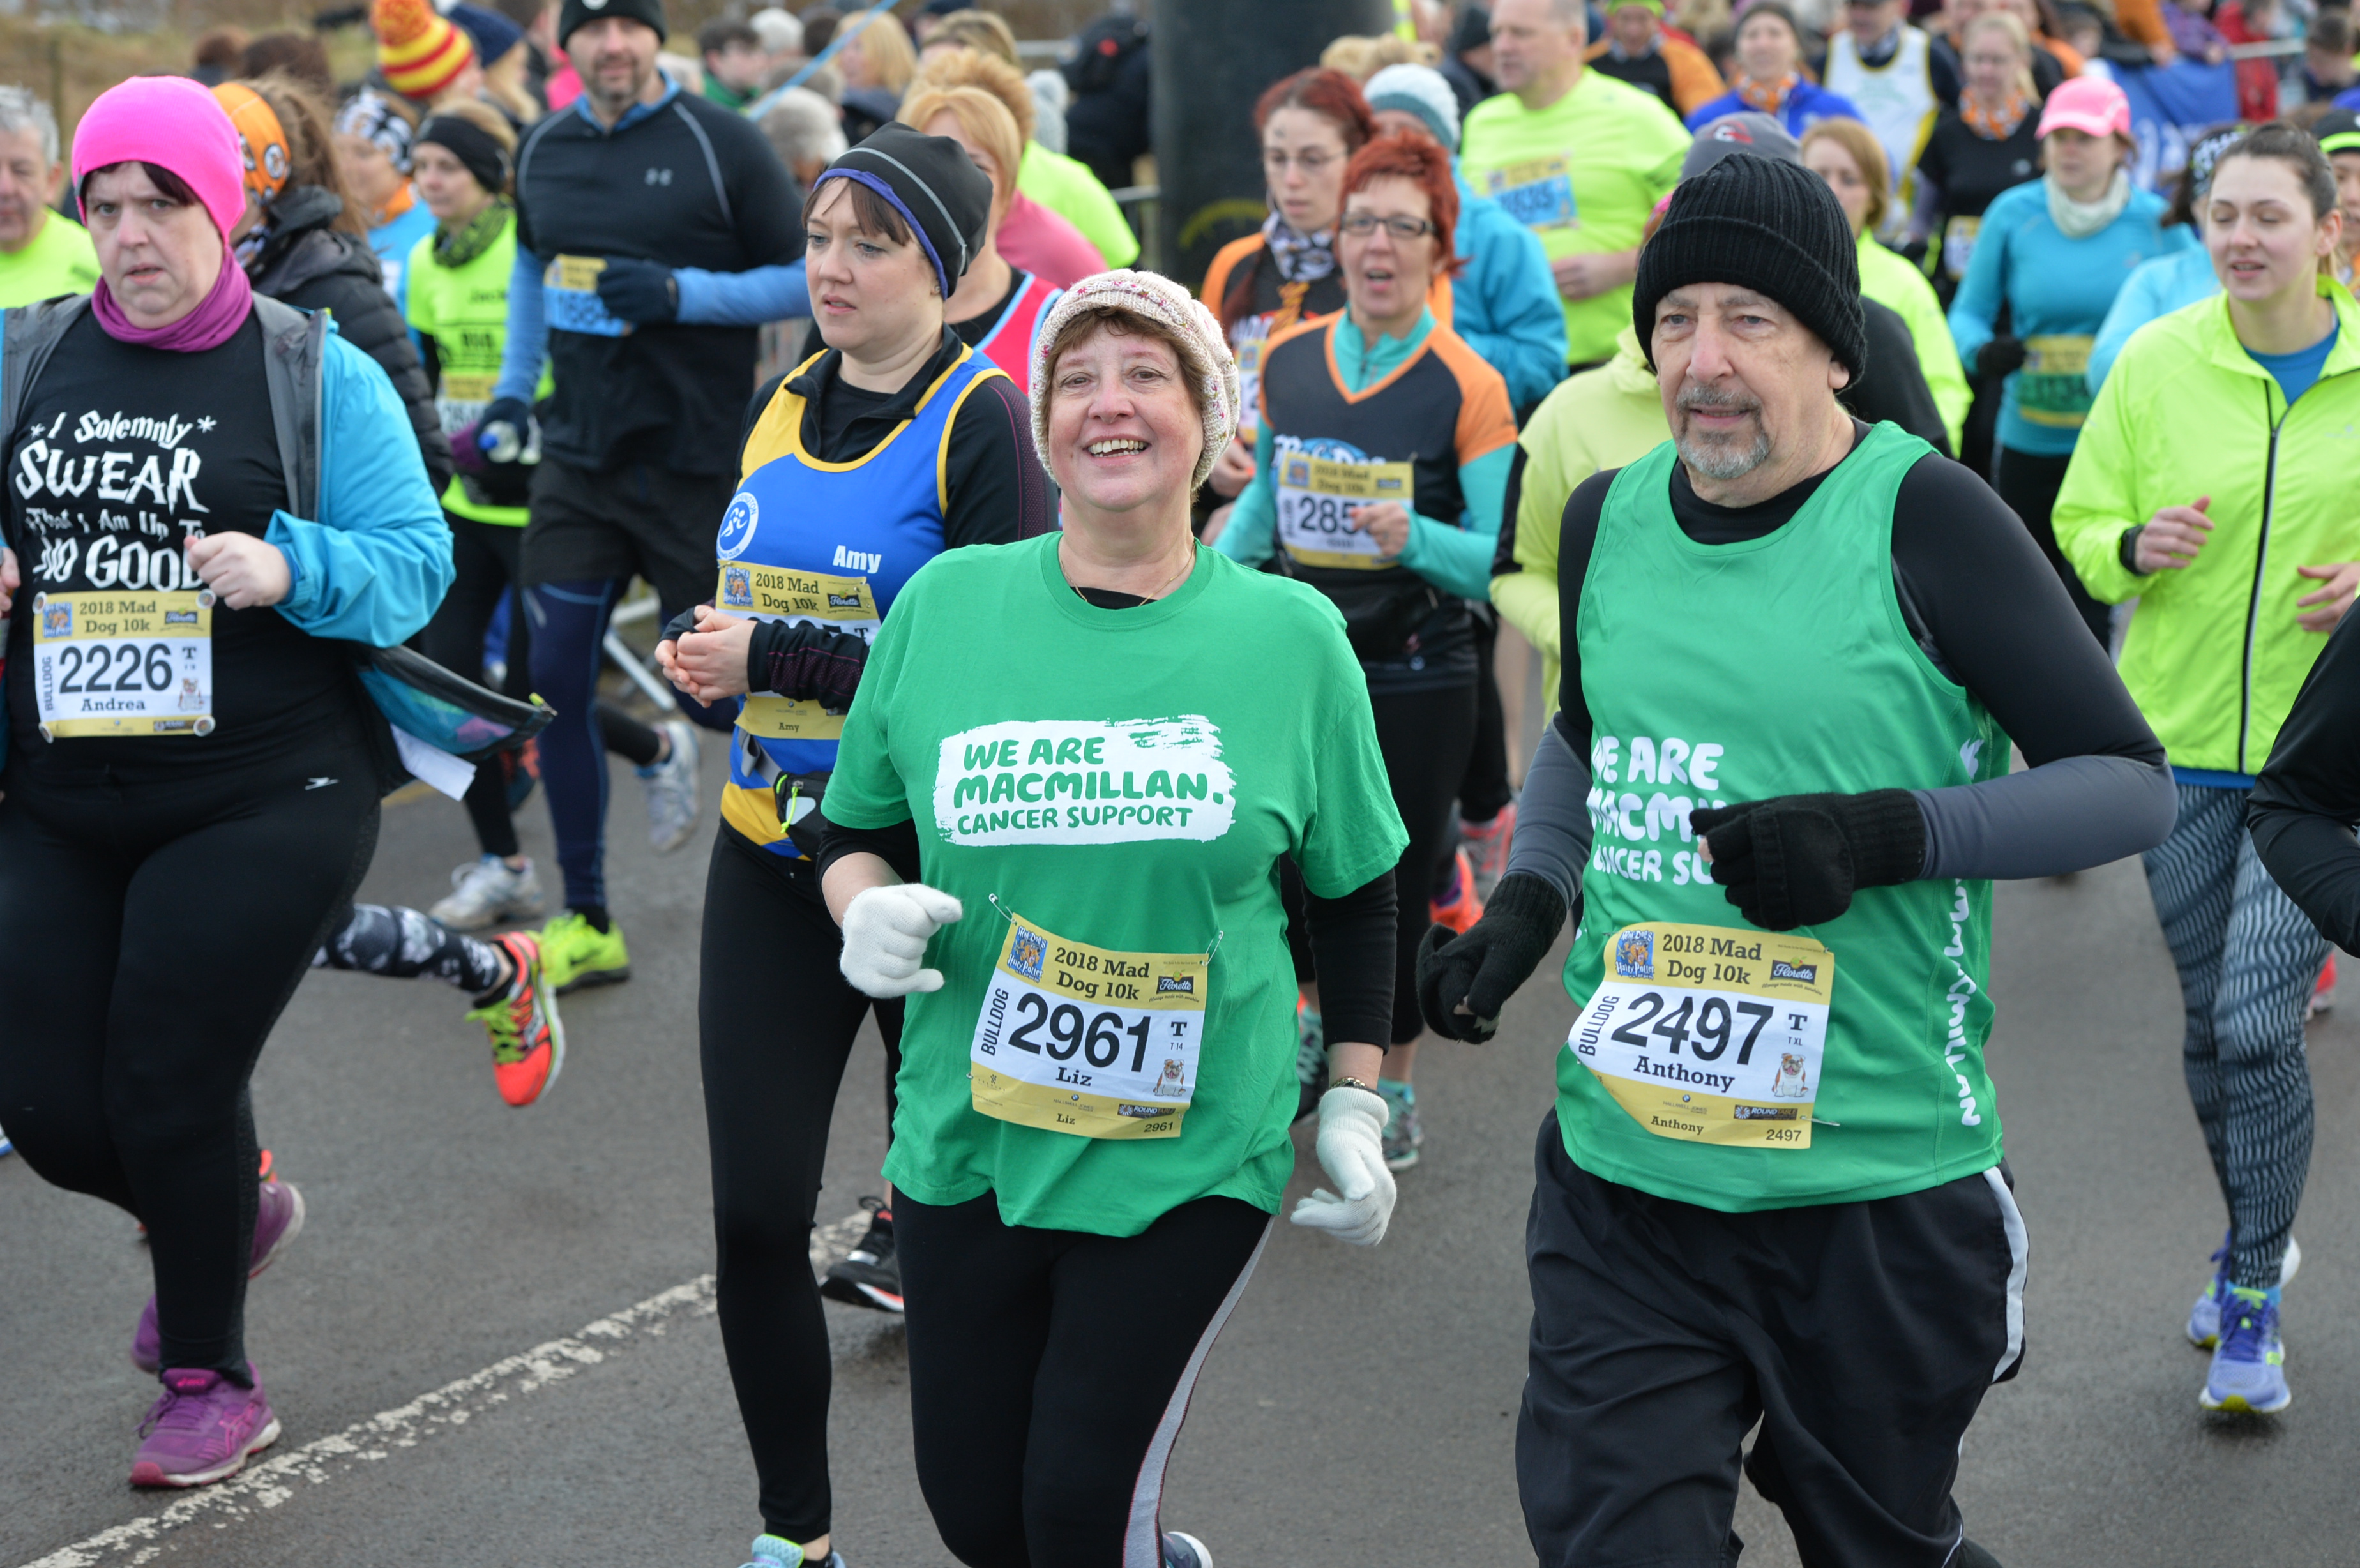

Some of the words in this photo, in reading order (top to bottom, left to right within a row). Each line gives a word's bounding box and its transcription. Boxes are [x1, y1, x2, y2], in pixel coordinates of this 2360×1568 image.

[47, 412, 67, 439] I
[74, 409, 193, 450] Solemnly
[15, 439, 210, 515] SWEAR
[98, 509, 130, 531] Am
[139, 510, 169, 542] Up
[1299, 495, 1376, 536] 285
[833, 545, 882, 574] Amy
[756, 573, 784, 590] 2018
[787, 577, 820, 594] Mad
[79, 601, 114, 615] 2018
[119, 601, 156, 614] Mad
[761, 593, 790, 613] Dog
[794, 597, 819, 612] 10k
[85, 620, 117, 635] Dog
[124, 619, 151, 631] 10k
[183, 647, 197, 660] T
[59, 643, 172, 694] 2226
[42, 656, 54, 711] BULLDOG
[80, 698, 146, 712] Andrea
[779, 722, 799, 733] Amy
[964, 739, 1020, 771] WE
[1028, 736, 1105, 765] ARE
[1627, 736, 1725, 791] ARE
[953, 769, 1224, 809] MACMILLAN.
[957, 808, 1058, 835] CANCER
[1067, 804, 1193, 827] SUPPORT
[1663, 933, 1706, 954] 2018
[1709, 937, 1762, 961] Mad
[1054, 947, 1099, 972] 2018
[1102, 958, 1150, 978] Mad
[1667, 960, 1707, 984] Dog
[1713, 963, 1751, 985] 10k
[1773, 963, 1813, 981] Florette
[1056, 970, 1100, 999] Dog
[1105, 981, 1140, 1000] 10k
[1159, 978, 1192, 991] Florette
[981, 988, 1009, 1057] BULLDOG
[1008, 992, 1151, 1073] 2961
[1170, 1021, 1188, 1037] T
[1578, 995, 1621, 1057] BULLDOG
[1610, 991, 1774, 1066] 2497
[1788, 1013, 1808, 1032] T
[1176, 1042, 1183, 1051] 14
[1794, 1037, 1803, 1046] XL
[1055, 1066, 1093, 1087] Liz
[1633, 1055, 1736, 1094] Anthony
[1056, 1113, 1076, 1126] Liz
[1144, 1121, 1174, 1133] 2961
[1651, 1115, 1704, 1136] Anthony
[1766, 1129, 1803, 1142] 2497
